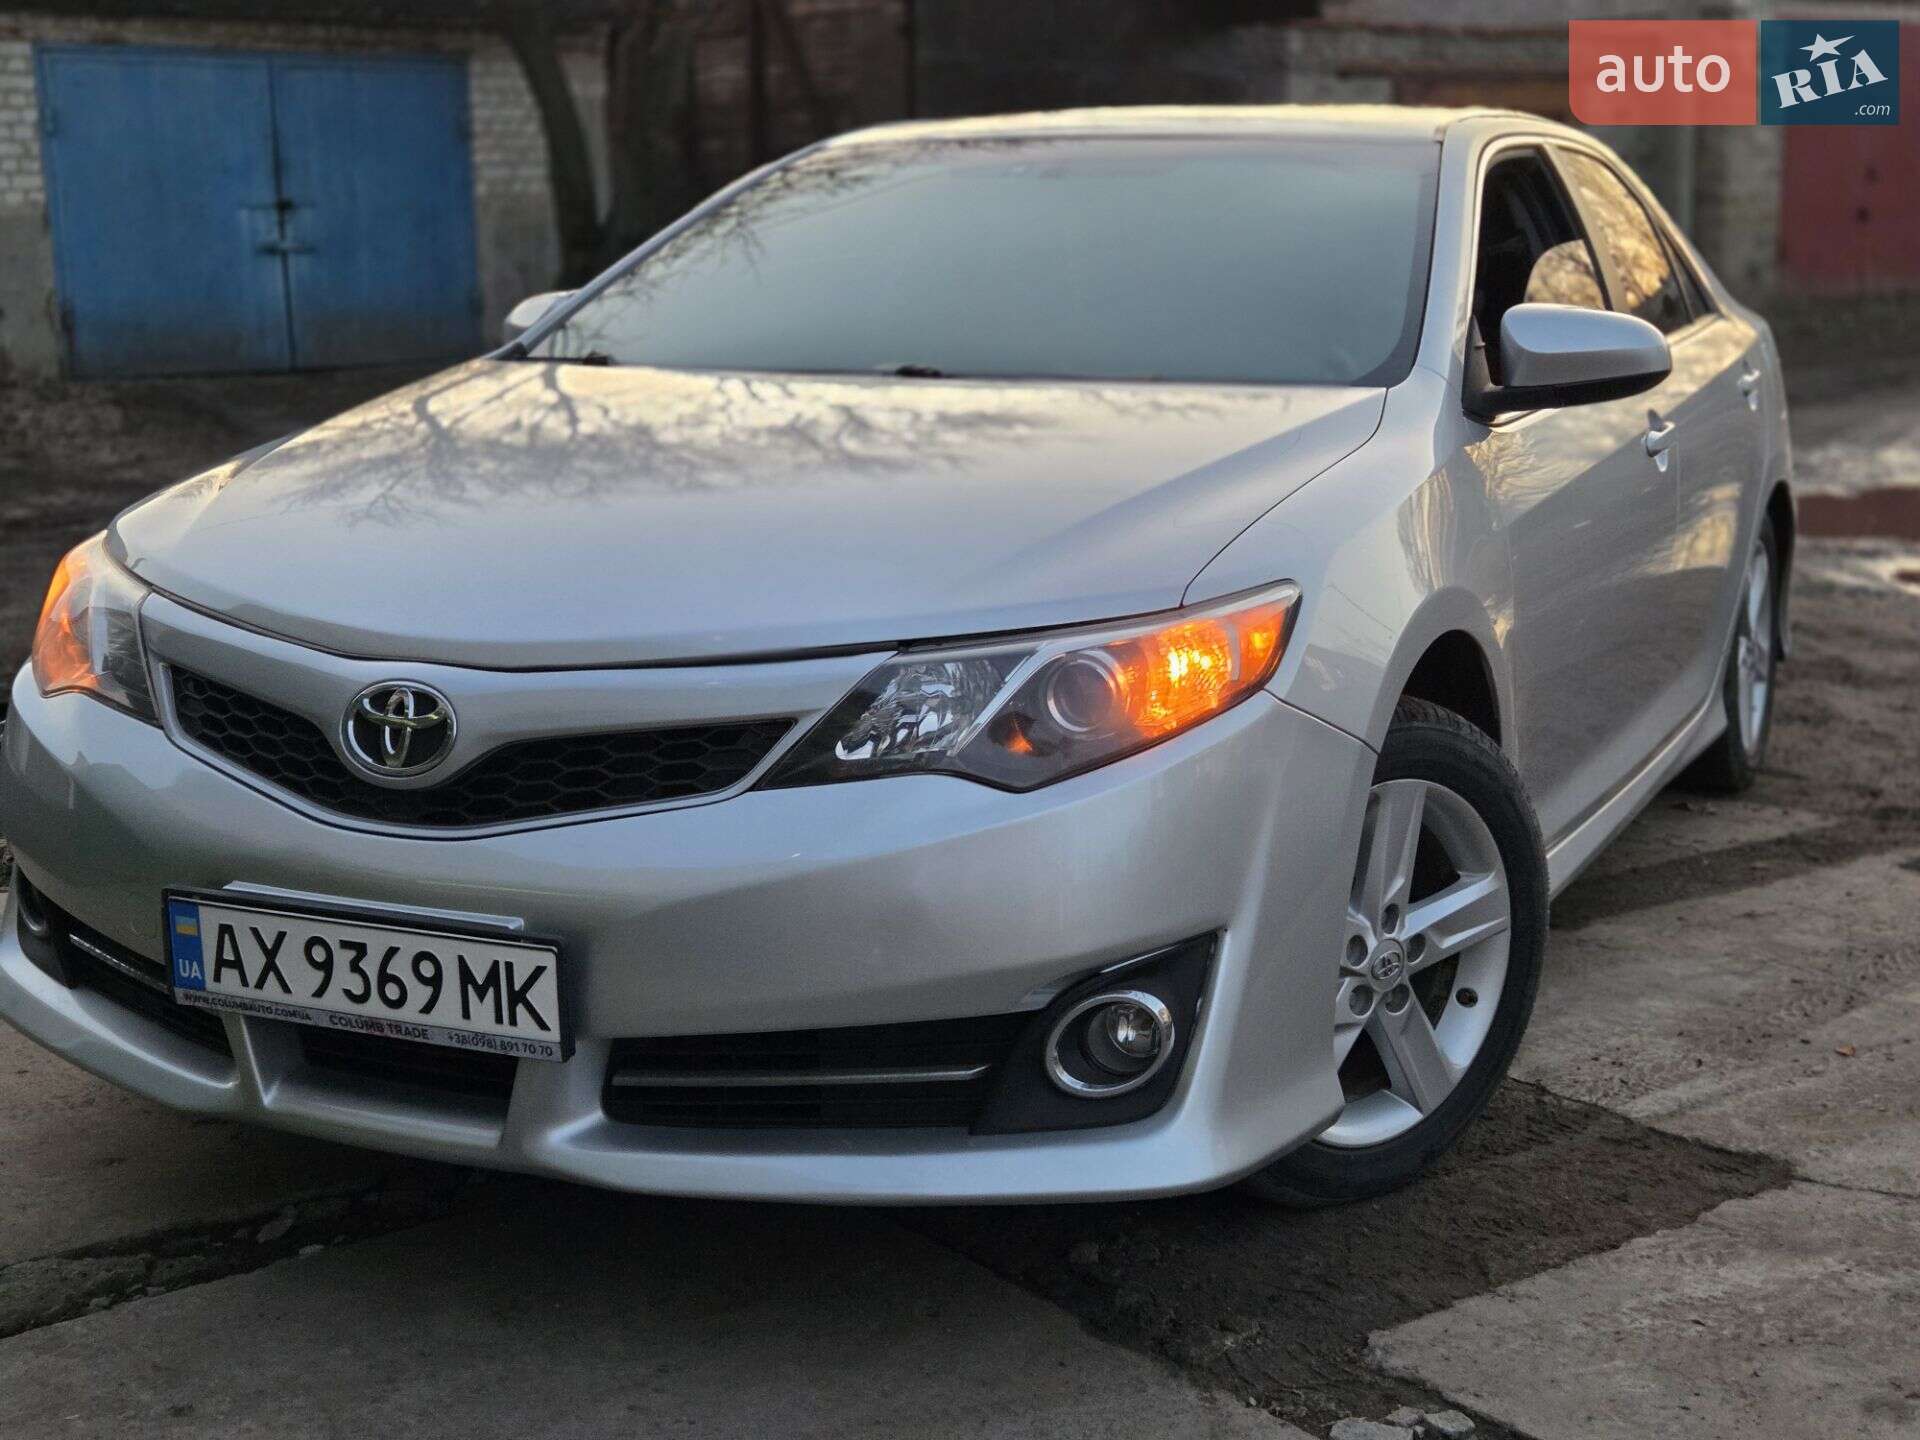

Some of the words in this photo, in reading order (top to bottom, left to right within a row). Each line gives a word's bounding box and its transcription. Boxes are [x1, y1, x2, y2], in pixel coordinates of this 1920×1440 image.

[178, 959, 202, 980] UA
[213, 923, 292, 994] AX
[303, 936, 443, 1014] 9369
[457, 954, 552, 1032] MK
[329, 1014, 385, 1034] COLUMB
[386, 1021, 430, 1041] TRADE
[522, 1042, 537, 1054] 70
[539, 1045, 554, 1057] 70
